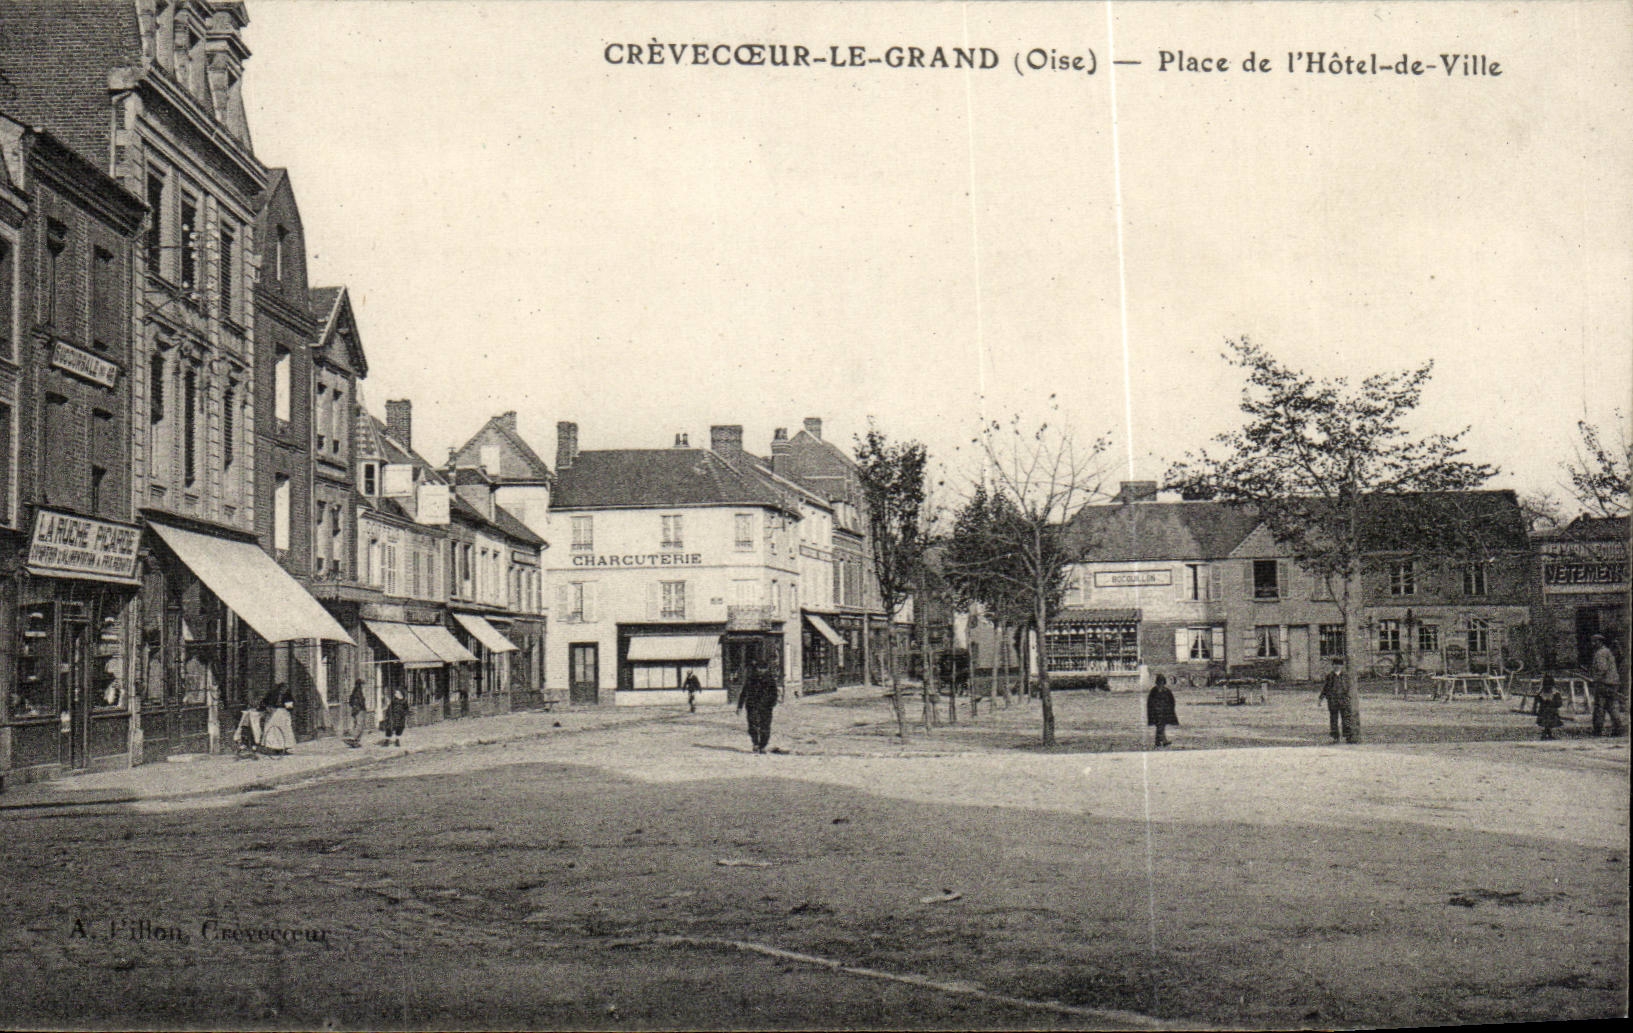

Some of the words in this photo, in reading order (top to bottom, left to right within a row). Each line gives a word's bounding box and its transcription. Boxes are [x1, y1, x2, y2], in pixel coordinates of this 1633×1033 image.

[39, 514, 55, 542] LA
[56, 517, 92, 549] RUCHE
[95, 526, 135, 554] PICARDE
[572, 553, 702, 567] CHARCUTERIE
